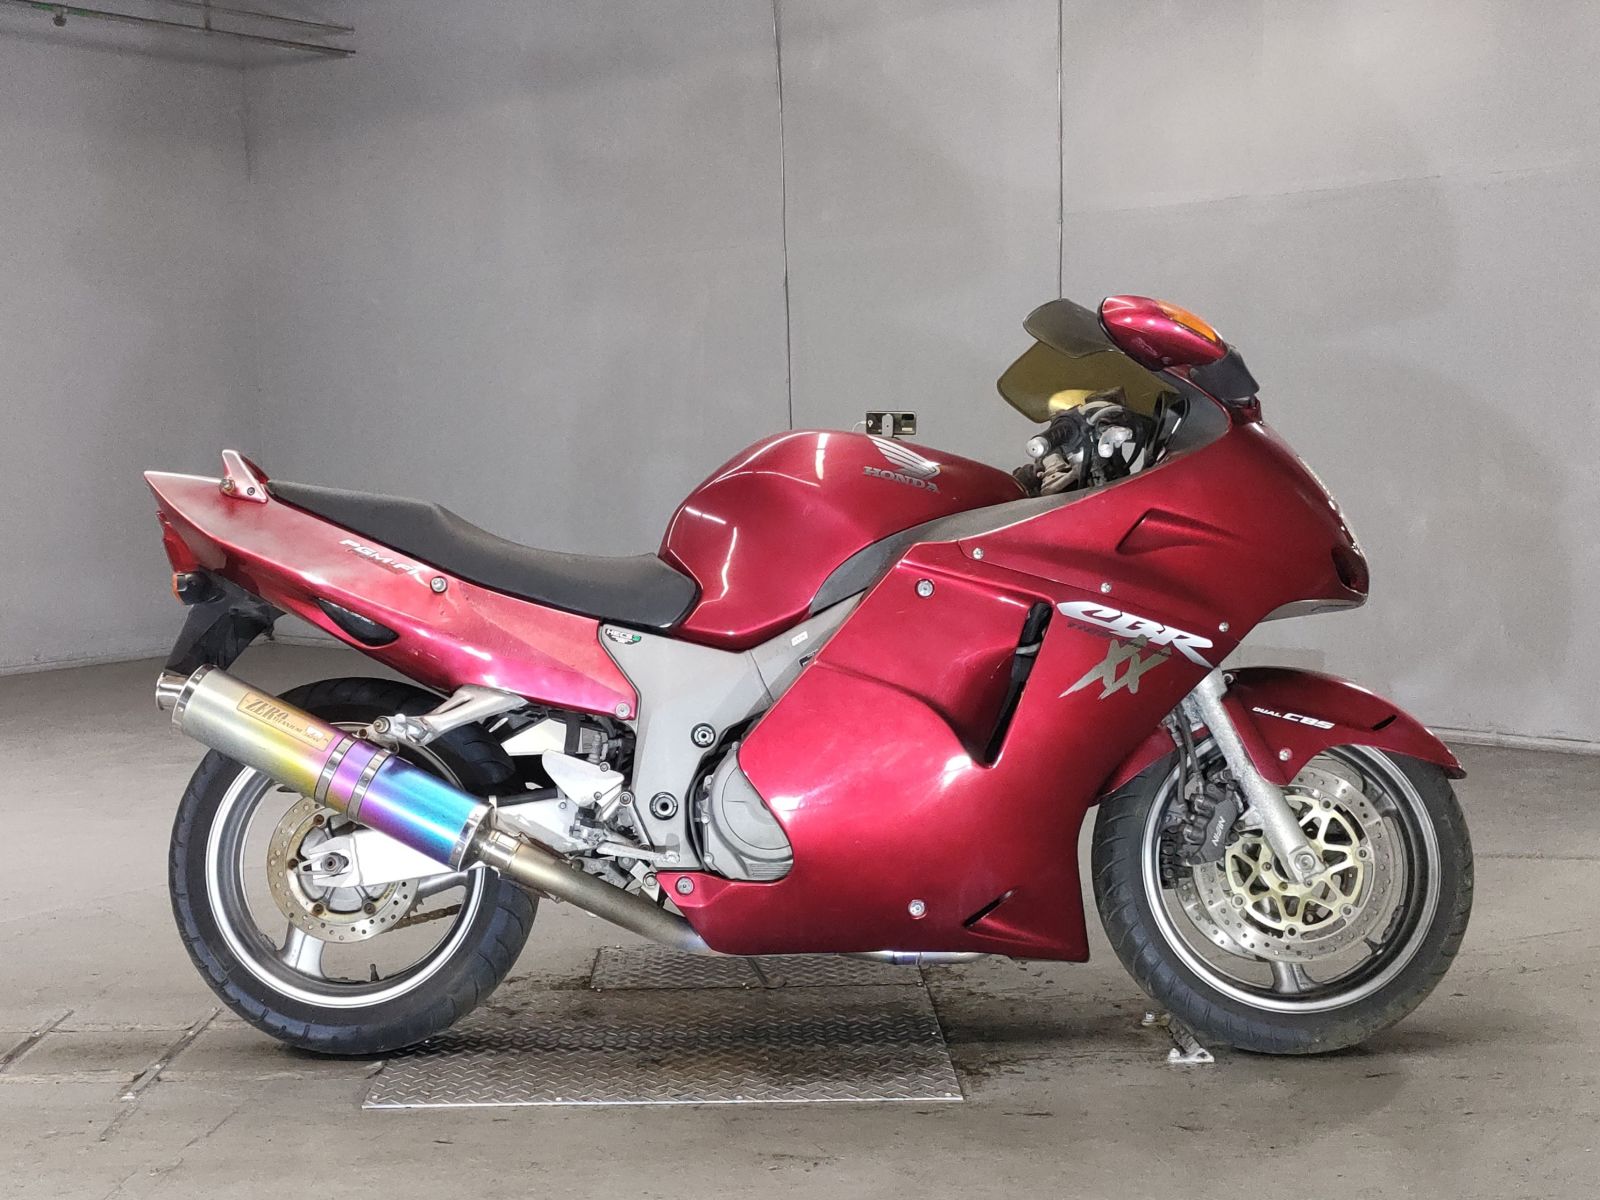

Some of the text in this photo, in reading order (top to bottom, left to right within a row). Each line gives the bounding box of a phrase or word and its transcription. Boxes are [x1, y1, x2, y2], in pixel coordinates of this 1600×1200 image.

[863, 466, 941, 493] HONDA
[1056, 601, 1214, 669] CBR
[1058, 634, 1172, 700] XX
[245, 699, 289, 720] ZERO
[1252, 706, 1335, 730] DUAL CBS
